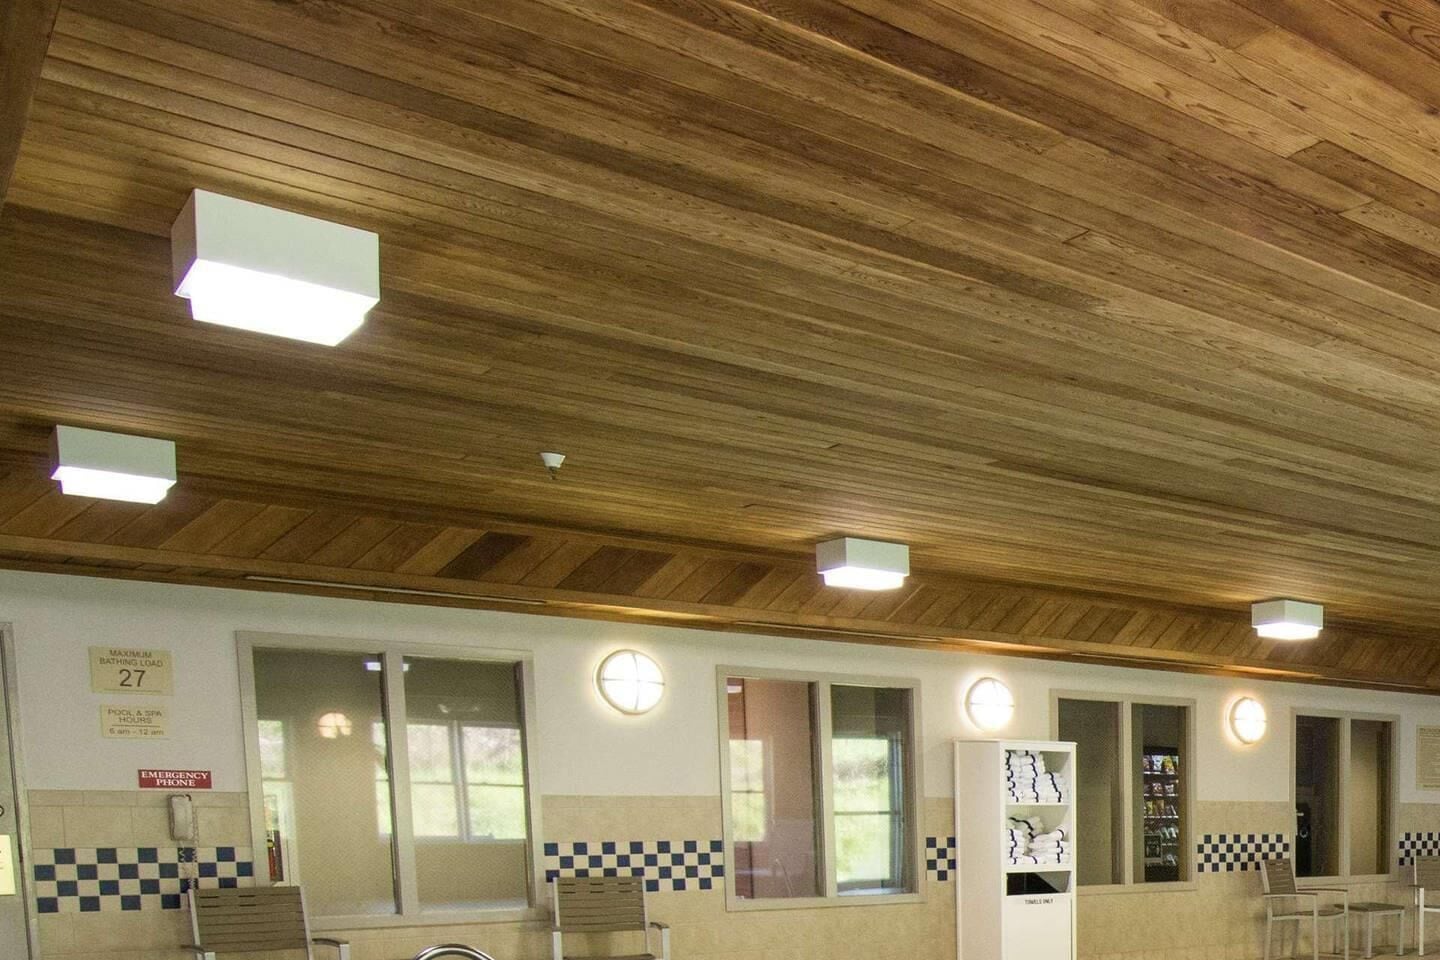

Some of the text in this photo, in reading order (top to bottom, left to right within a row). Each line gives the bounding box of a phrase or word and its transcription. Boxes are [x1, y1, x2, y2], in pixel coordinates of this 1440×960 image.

[109, 649, 152, 658] MAXIMUM
[99, 657, 163, 667] BATHING LOAD
[119, 669, 146, 687] 27
[141, 771, 208, 779] EMERGENCY
[156, 779, 196, 787] PHONE
